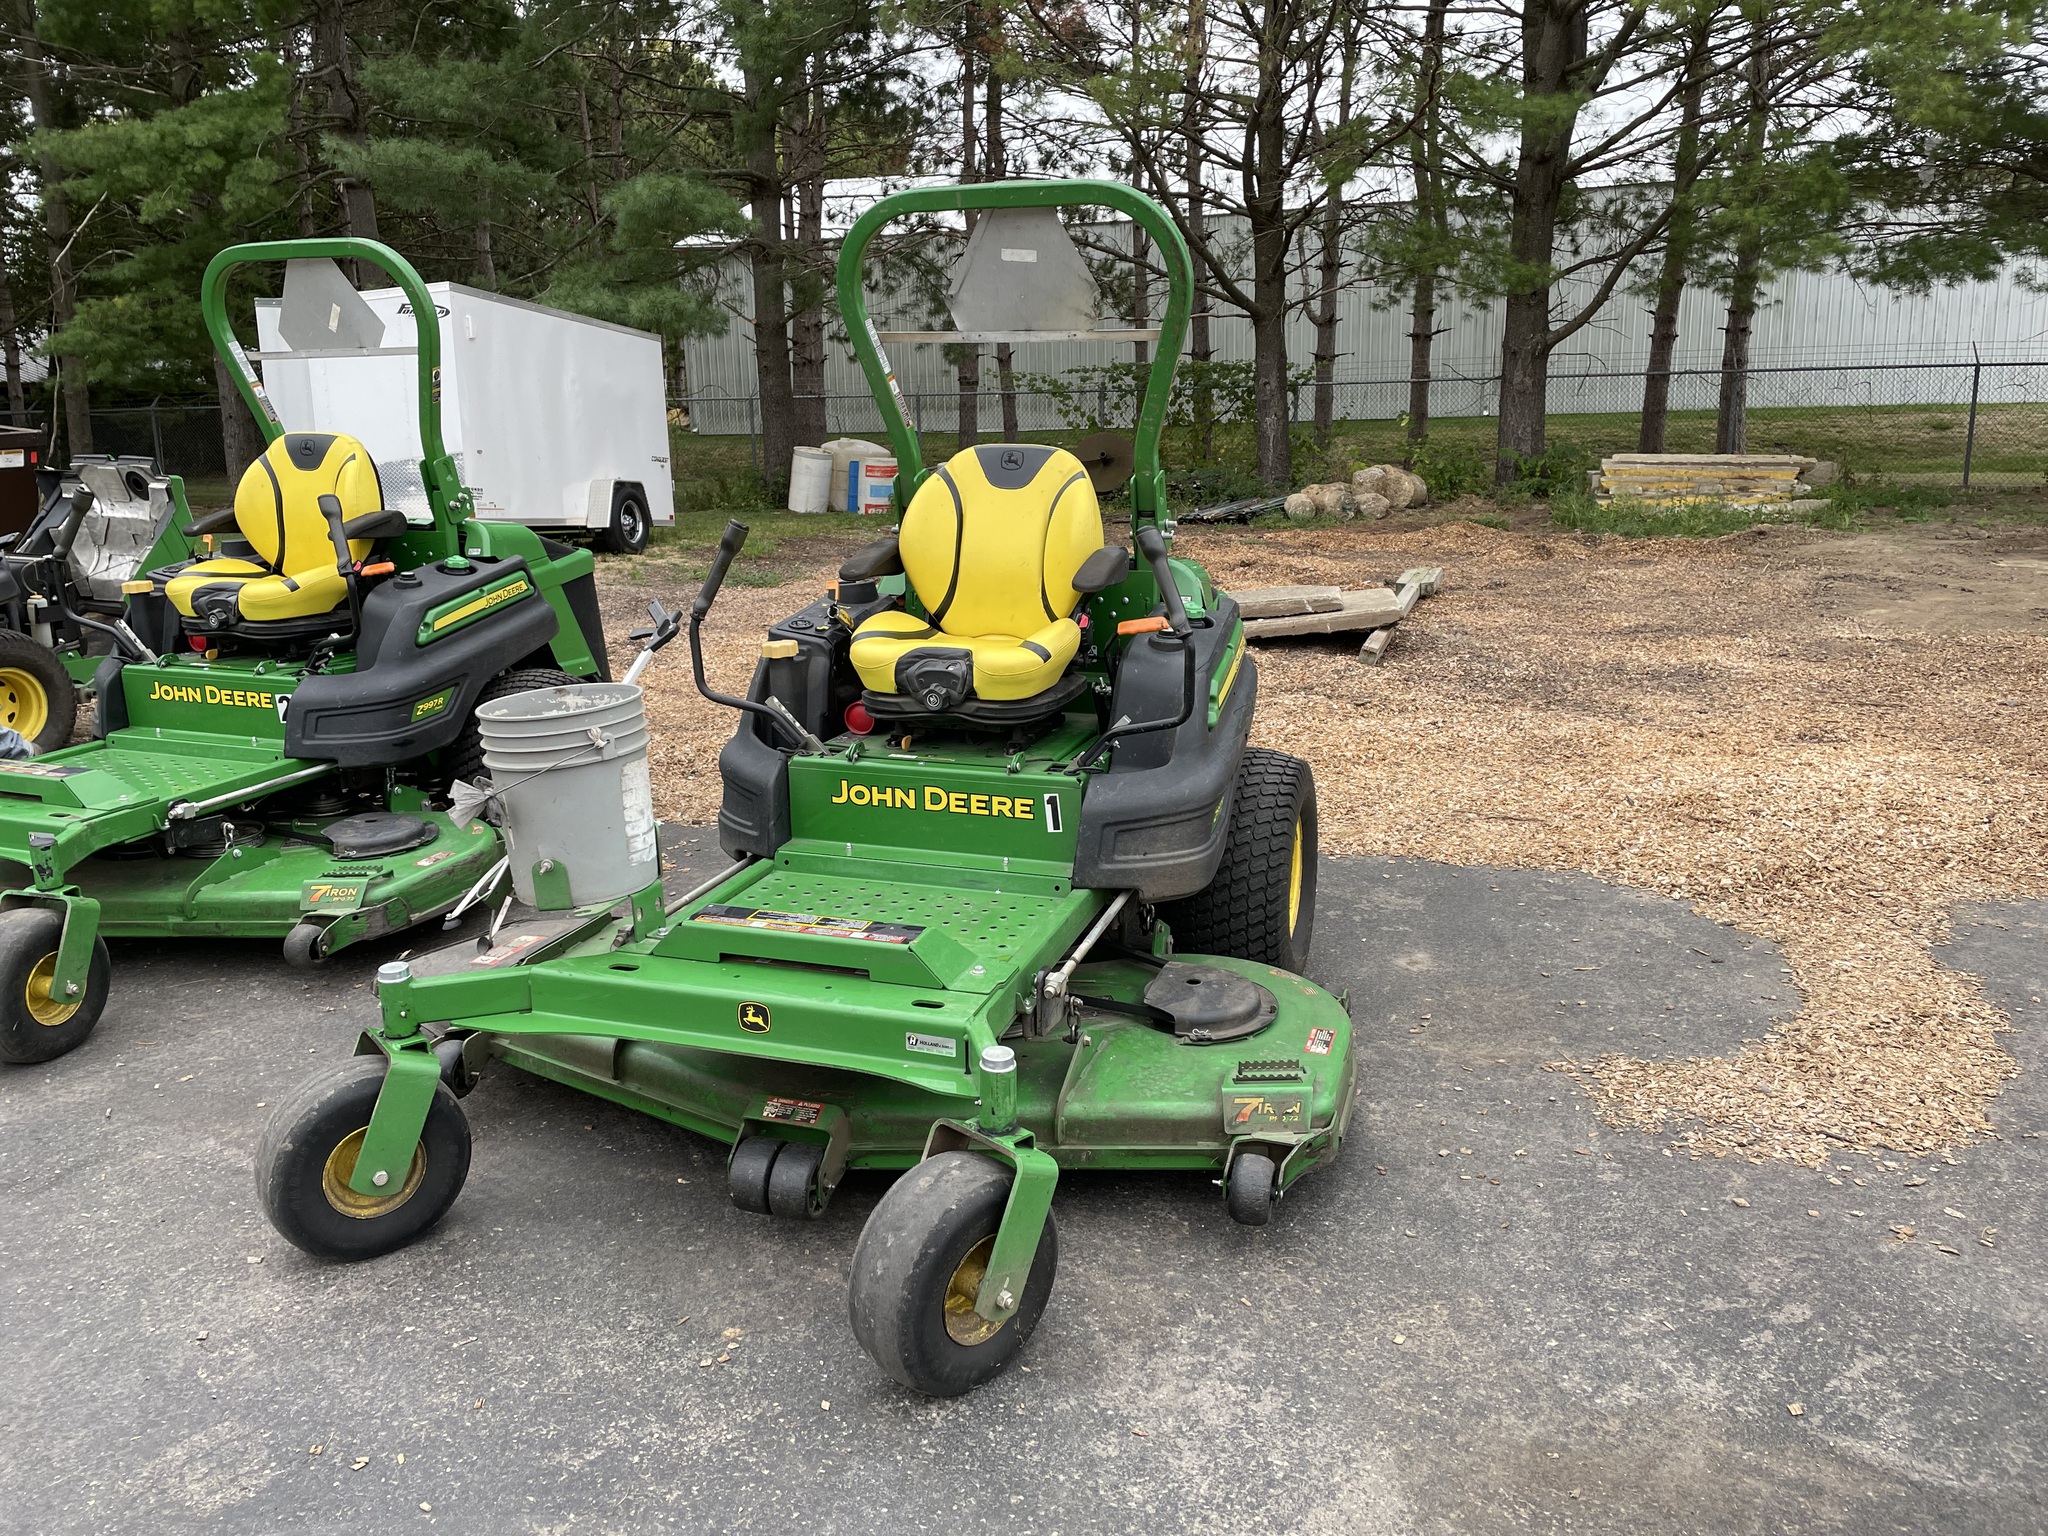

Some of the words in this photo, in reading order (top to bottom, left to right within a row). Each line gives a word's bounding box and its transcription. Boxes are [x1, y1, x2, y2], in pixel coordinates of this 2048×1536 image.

[485, 593, 503, 607] JOHN
[502, 583, 524, 598] DEERE
[150, 681, 202, 703] JOHN
[204, 685, 274, 709] DEERE
[416, 697, 443, 715] Z997R
[831, 779, 916, 810] JOHN
[923, 785, 1035, 820] DEERE
[1046, 795, 1061, 831] 1
